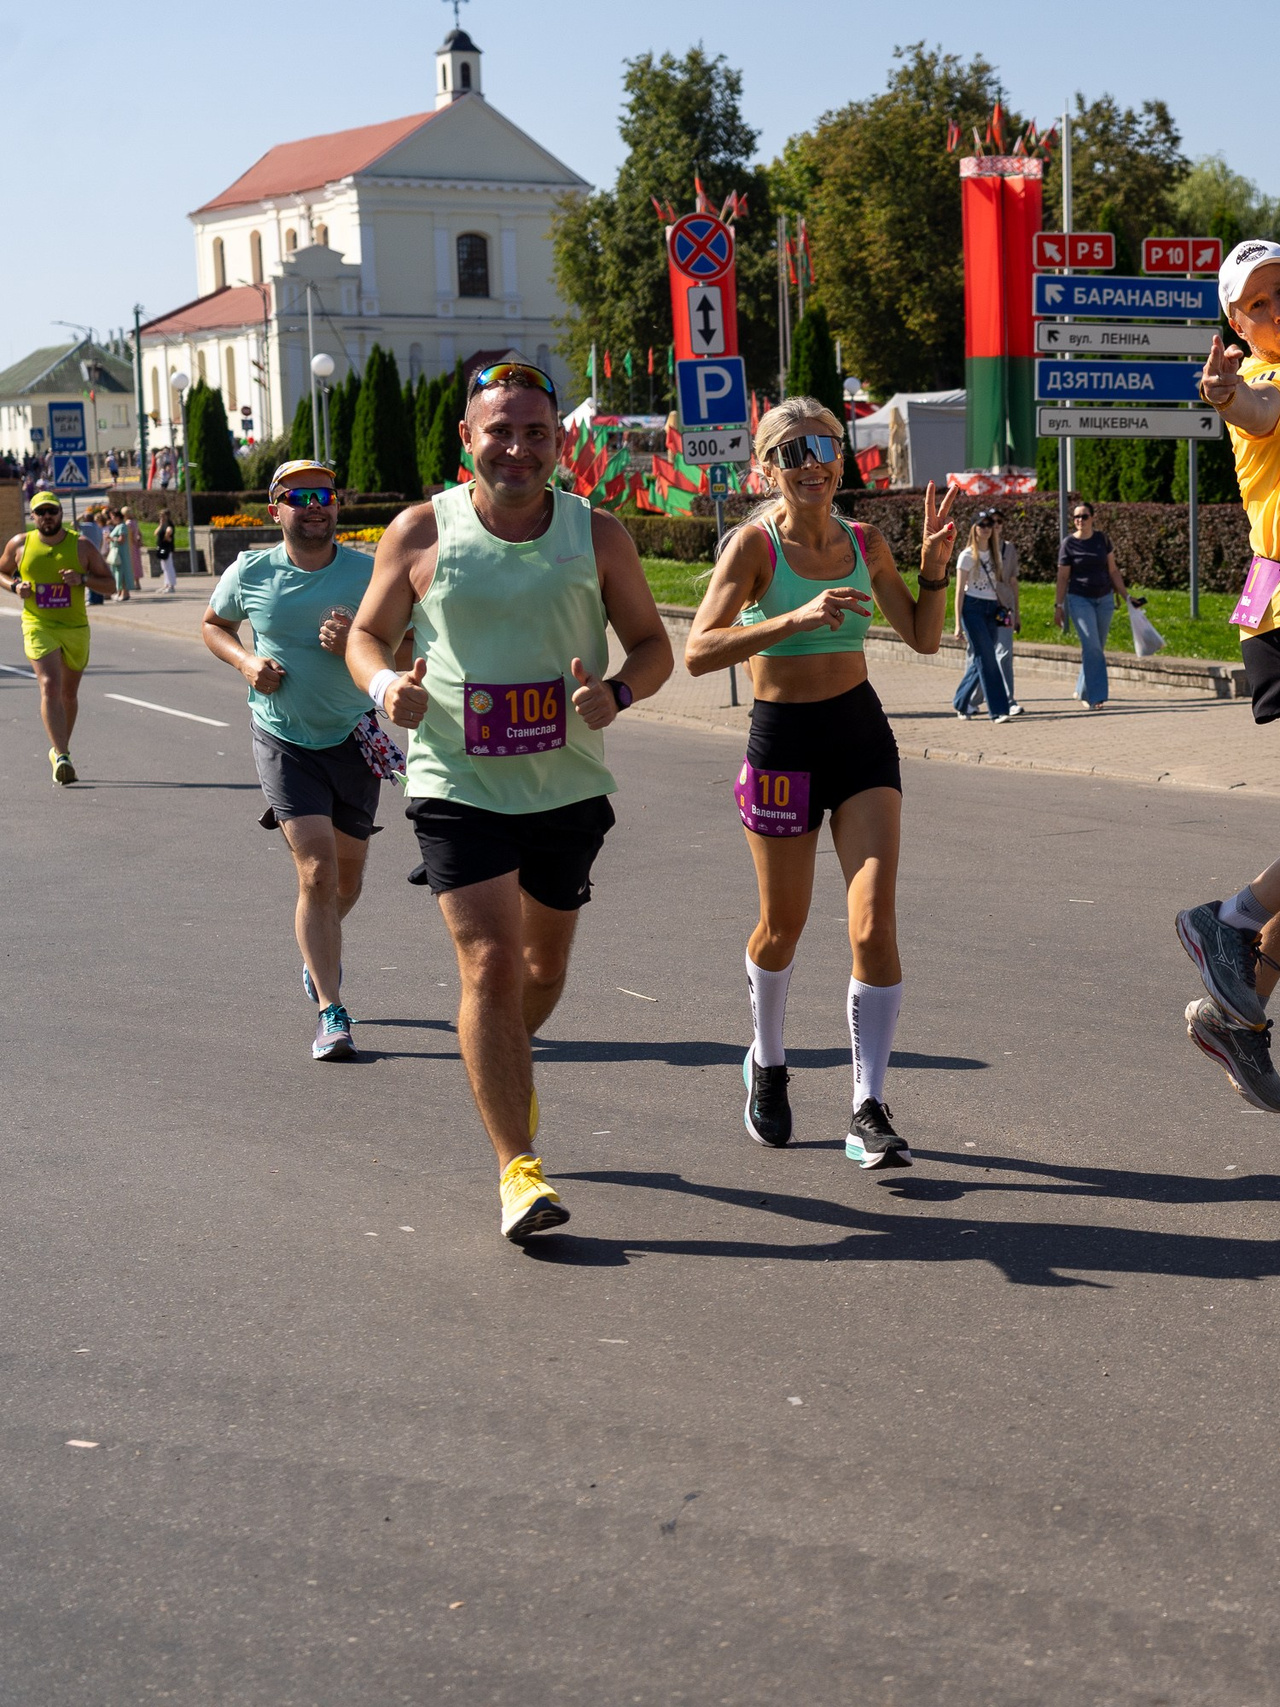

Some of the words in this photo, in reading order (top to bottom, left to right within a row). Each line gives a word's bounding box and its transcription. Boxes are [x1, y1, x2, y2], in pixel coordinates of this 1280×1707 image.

[1093, 242, 1104, 260] 5
[1166, 247, 1184, 265] 10
[1073, 287, 1203, 309] БАРАНАВІЧЫ
[1069, 334, 1093, 347] вул.
[1100, 332, 1151, 346] ЛЕНІНА
[1046, 371, 1155, 391] ДЗЯТЛАВА
[1048, 418, 1072, 430] вул.
[1079, 416, 1149, 431] МІЦКЕВІЧА
[687, 438, 718, 458] 300
[50, 584, 64, 598] 77
[505, 687, 558, 724] 106
[506, 724, 557, 739] Станислав
[758, 774, 790, 807] 10
[751, 804, 797, 820] Валентина
